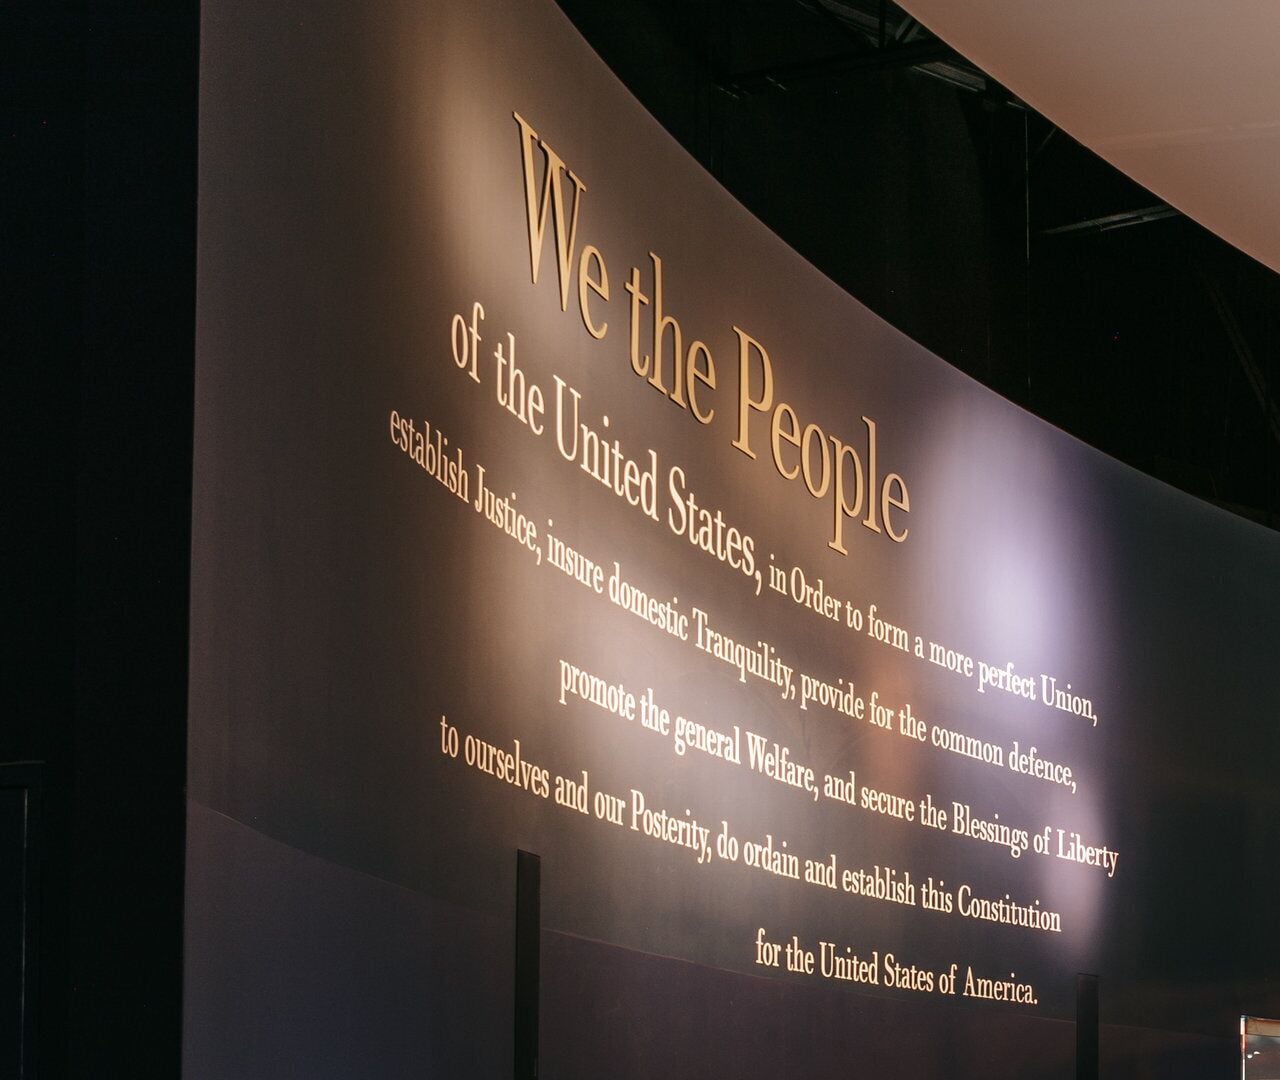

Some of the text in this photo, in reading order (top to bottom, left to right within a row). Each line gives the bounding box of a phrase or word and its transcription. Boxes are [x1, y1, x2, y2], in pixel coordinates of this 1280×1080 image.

[513, 111, 911, 555] We the People
[390, 410, 1077, 793] establish Justice, insure domestic Tranquility, provide for the common defence,
[452, 302, 1097, 726] of the United States, in Order to form a more perfect Union,
[440, 716, 1061, 932] to ourselves and our Posterity, do ordain and establish this Constitution
[559, 660, 1119, 877] promote the general Welfare, and secure the Blessings of Liberty
[756, 928, 1038, 1004] for the United States of America.
